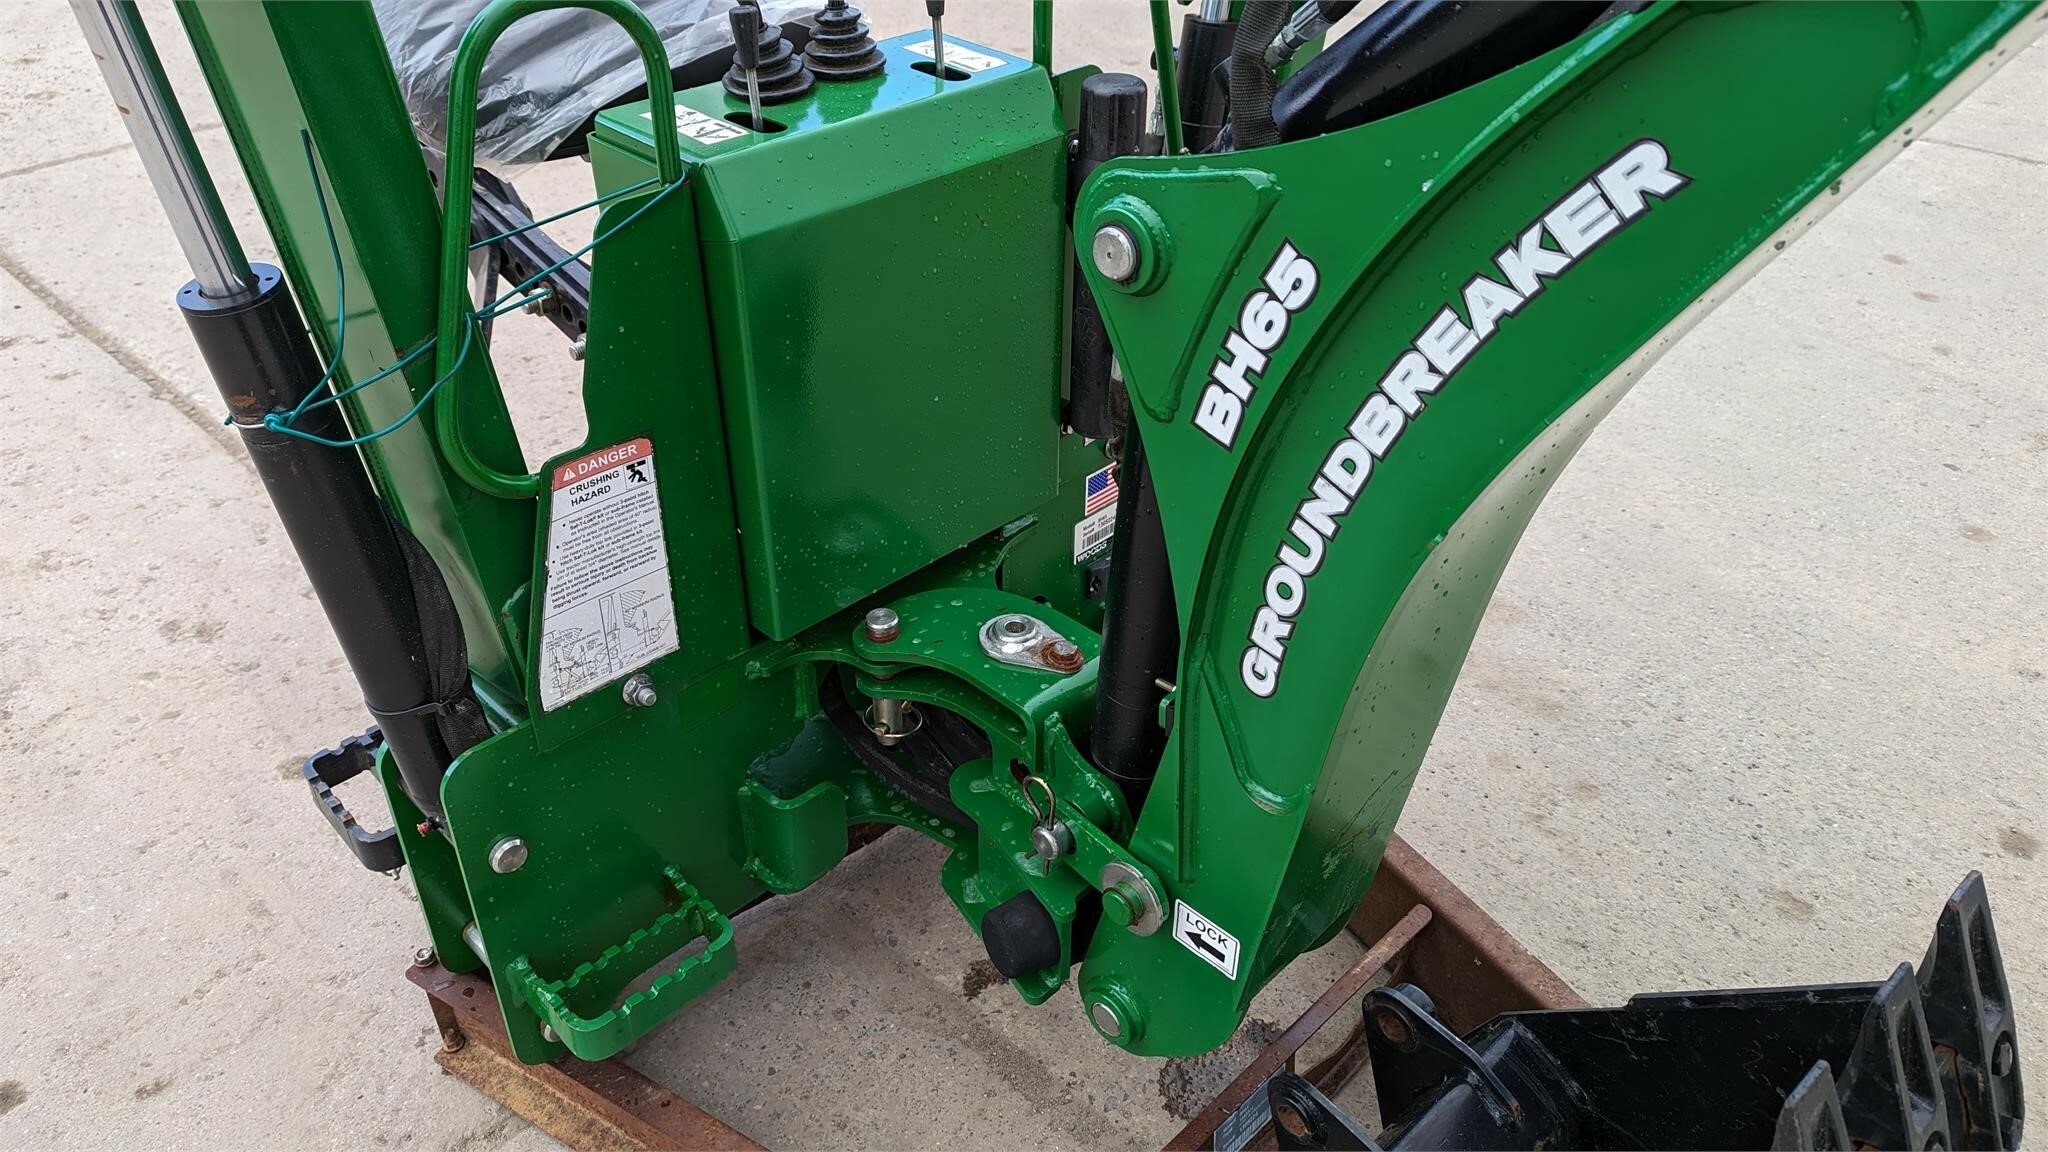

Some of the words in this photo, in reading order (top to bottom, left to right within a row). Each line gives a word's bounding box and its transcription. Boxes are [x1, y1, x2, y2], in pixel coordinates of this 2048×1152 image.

[1193, 240, 1320, 450] BH65
[1240, 138, 1694, 698] GROUNDBREAKER
[578, 444, 638, 475] DANGER
[569, 470, 620, 496] CRUSHING
[571, 485, 611, 507] HAZARD
[599, 560, 613, 571] above
[1186, 912, 1228, 949] LOCK
